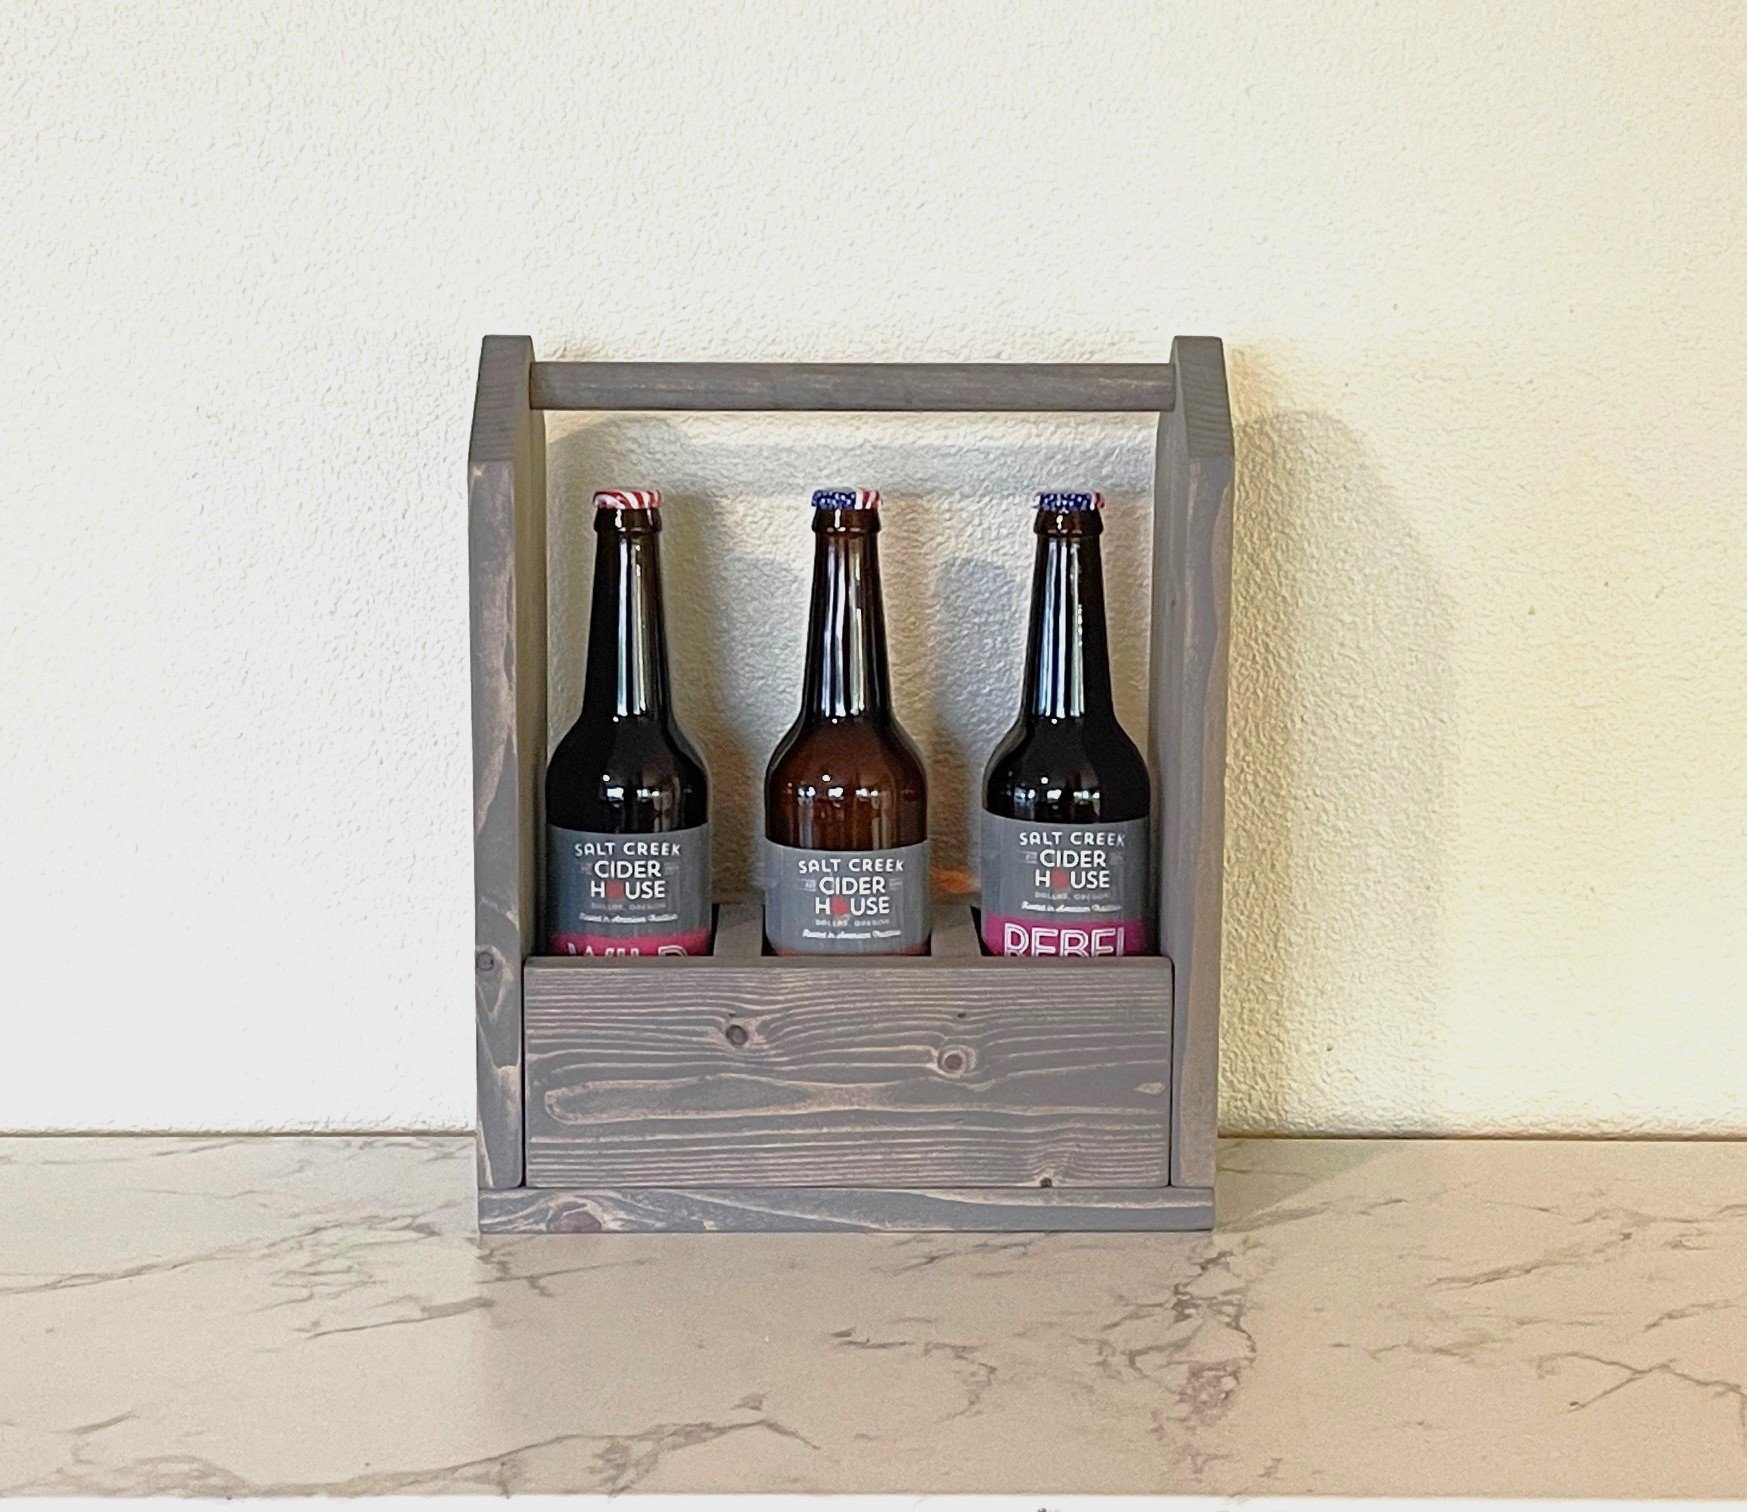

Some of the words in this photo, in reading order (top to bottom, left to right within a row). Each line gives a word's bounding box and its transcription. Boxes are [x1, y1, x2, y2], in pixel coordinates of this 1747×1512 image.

[1019, 832, 1063, 846] SALT
[1069, 831, 1126, 847] CREEK
[574, 842, 616, 857] SALT
[623, 842, 681, 856] CREEK
[798, 858, 841, 874] SALT
[848, 858, 904, 872] CREEK
[1039, 849, 1106, 868] CIDER
[594, 860, 662, 878] CIDER
[819, 876, 886, 895] CIDER
